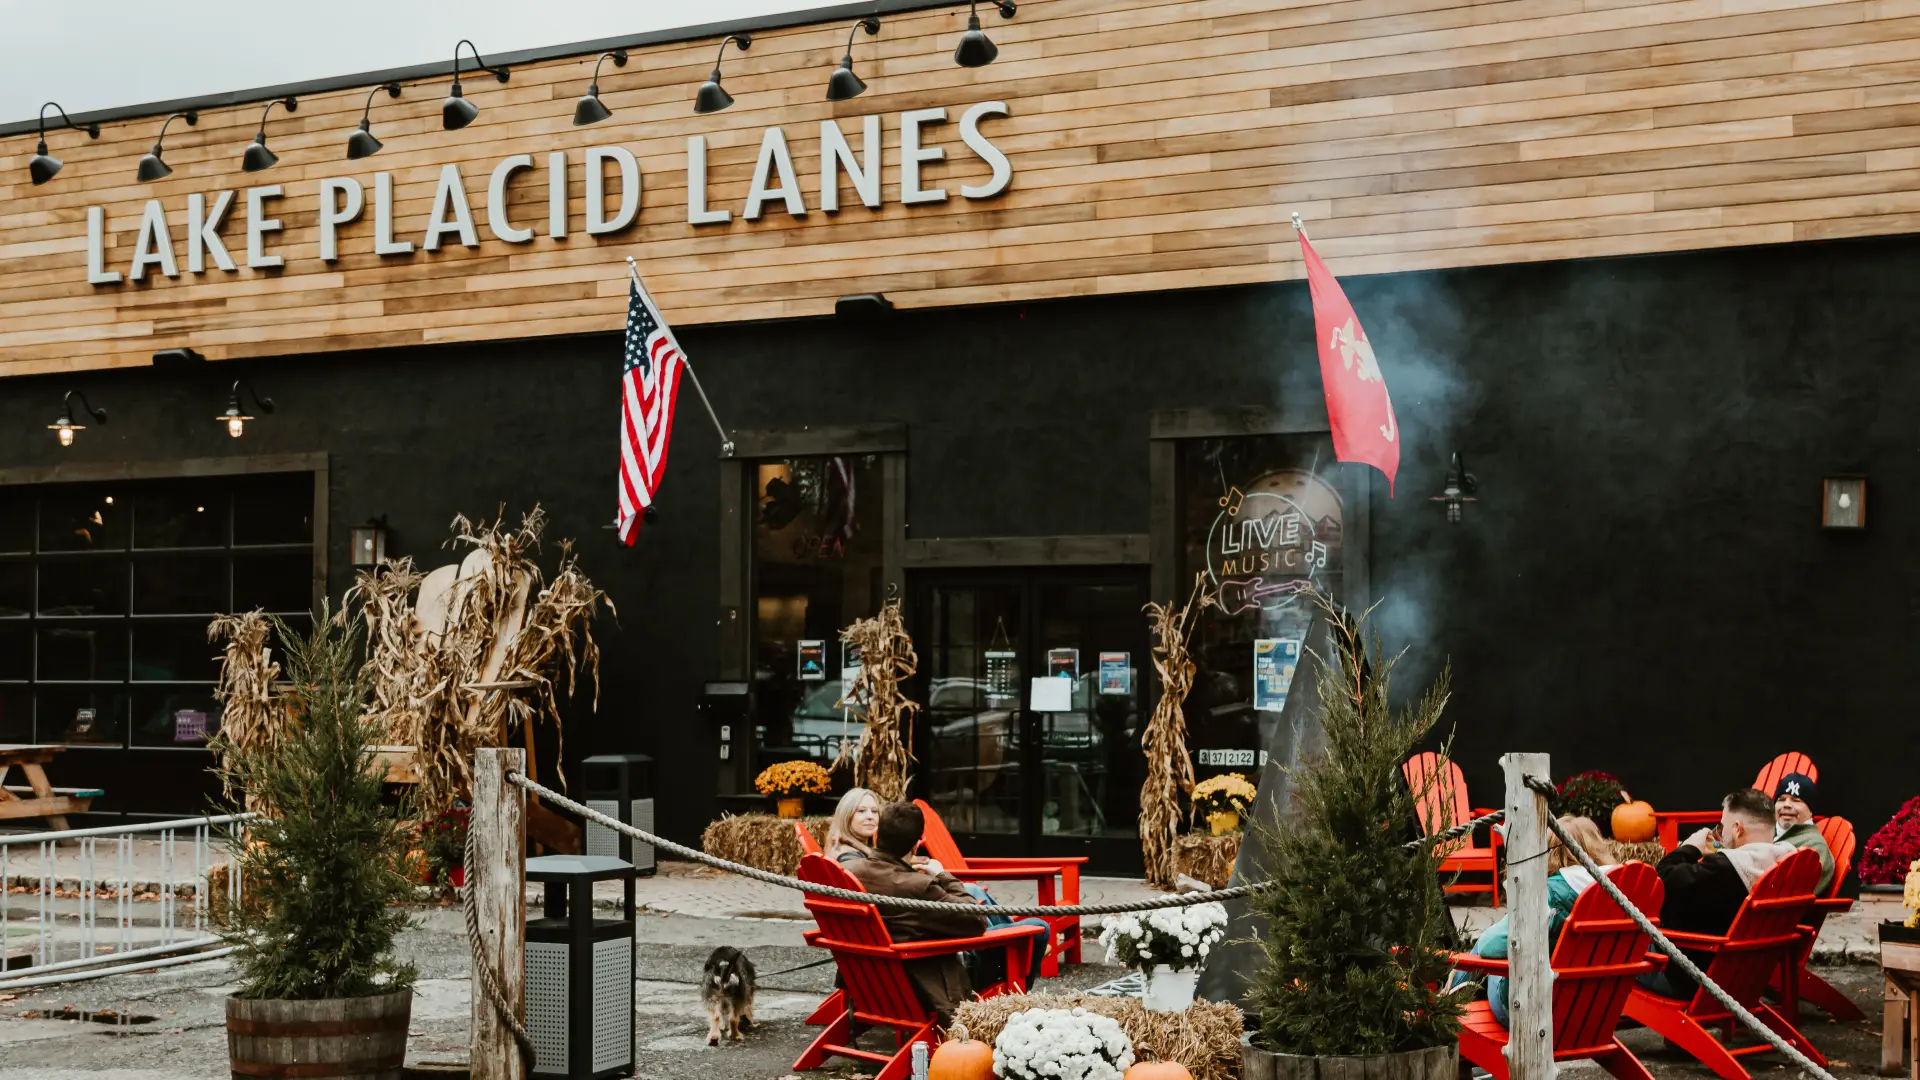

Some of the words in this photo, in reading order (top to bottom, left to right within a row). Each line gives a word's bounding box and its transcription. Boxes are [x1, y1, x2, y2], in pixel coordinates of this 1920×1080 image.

[87, 184, 286, 285] LAKE
[320, 146, 643, 261] PLACID
[688, 100, 1014, 225] LANES
[793, 534, 846, 560] OPEN
[1221, 512, 1300, 555] LIVE
[1221, 548, 1298, 577] MUSIC
[1785, 781, 1800, 796] NY
